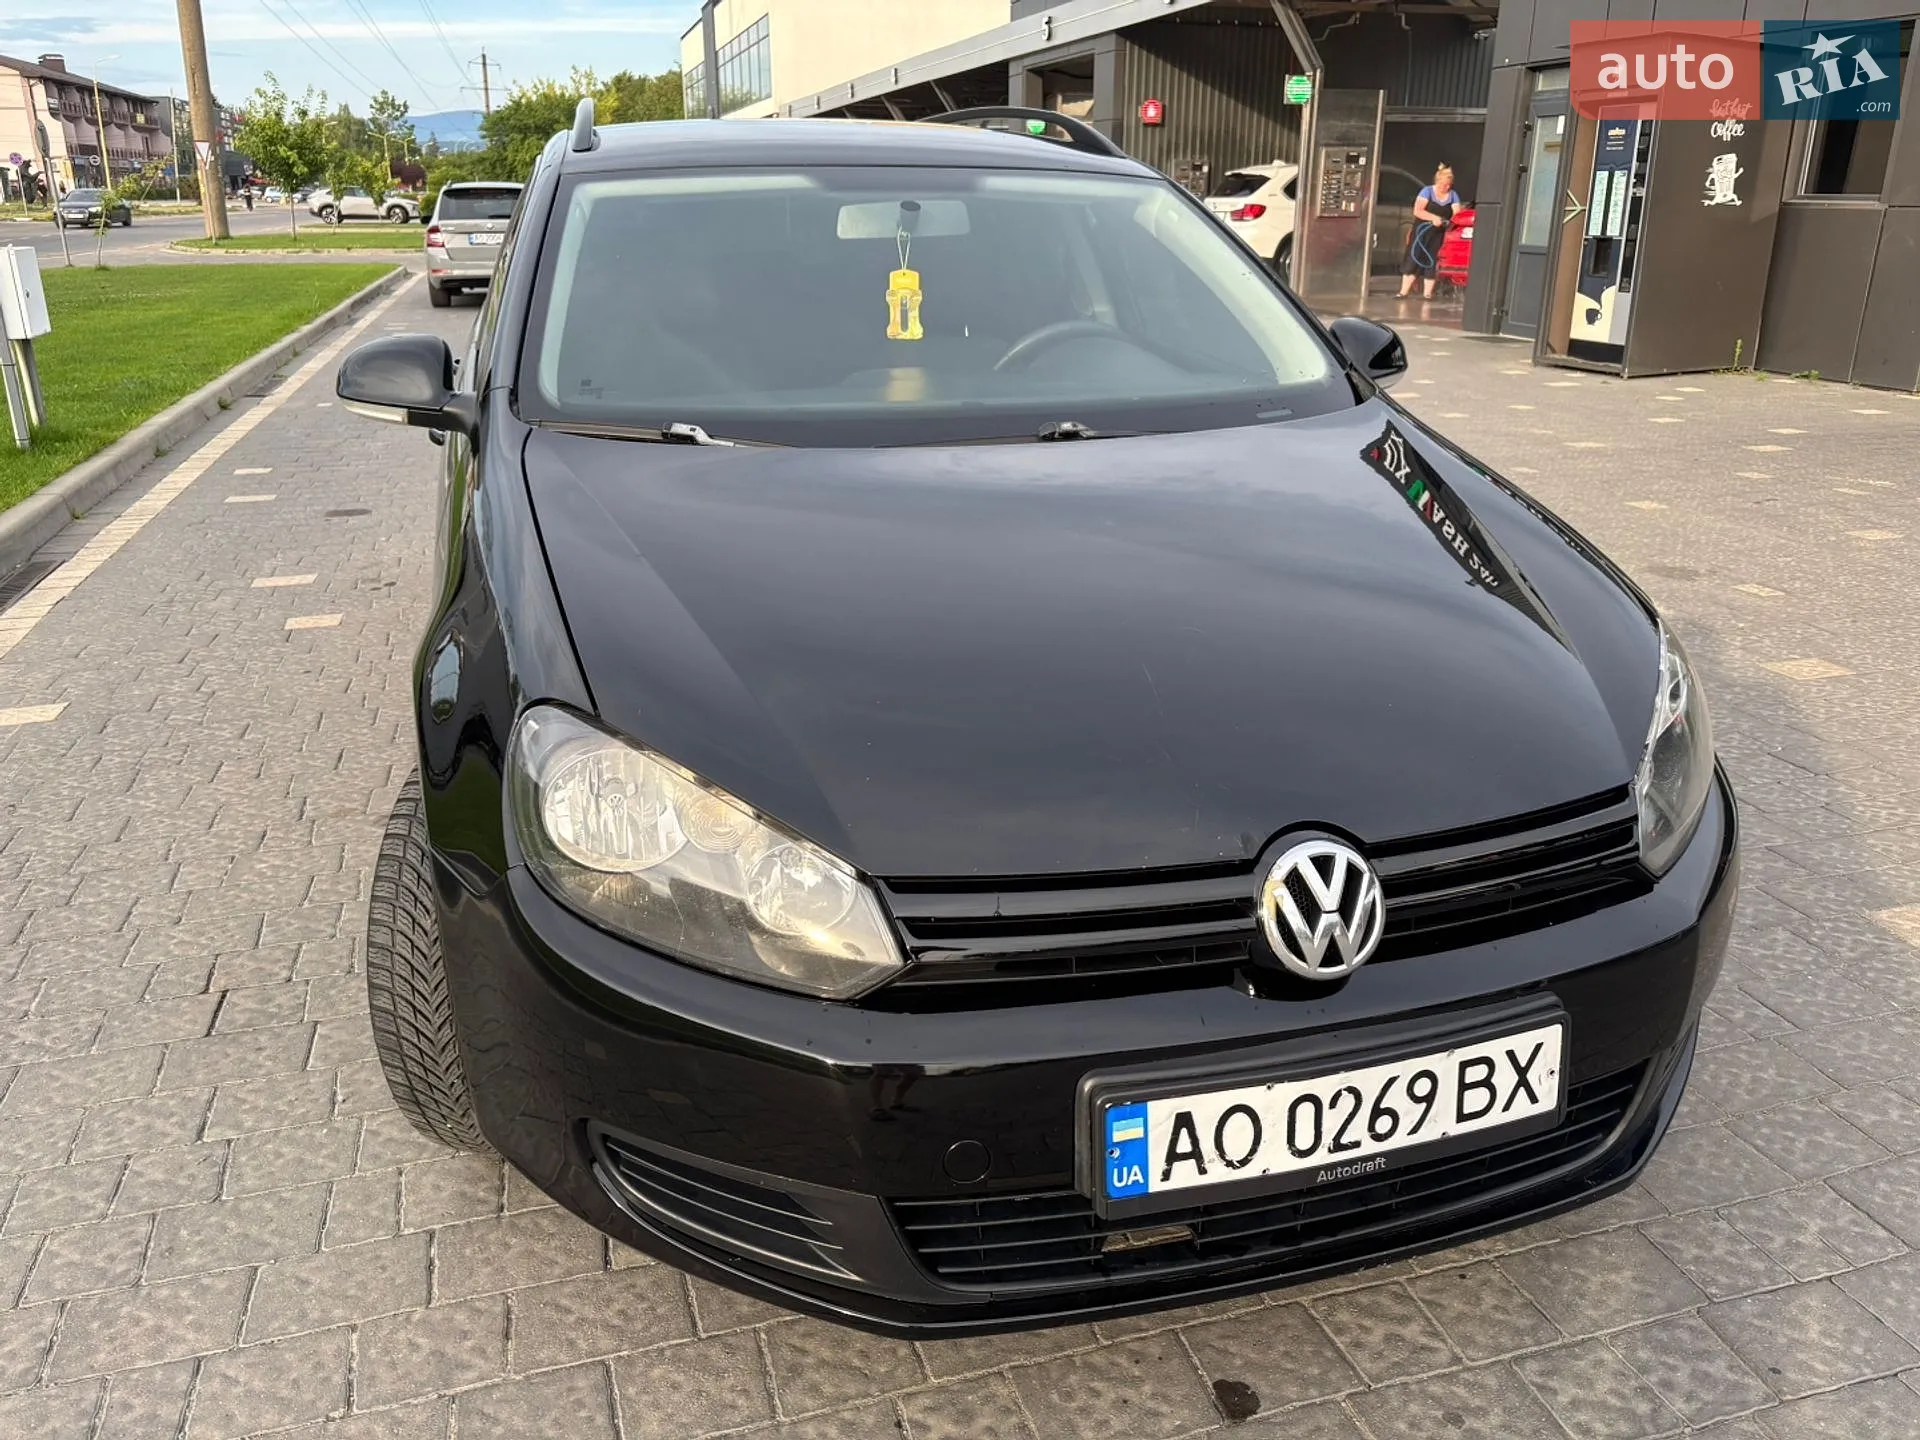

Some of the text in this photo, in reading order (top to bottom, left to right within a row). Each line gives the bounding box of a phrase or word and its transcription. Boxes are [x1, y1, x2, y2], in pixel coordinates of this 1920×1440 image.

[1160, 1041, 1545, 1182] AO 0269 BX
[1112, 1169, 1144, 1188] UA
[1317, 1157, 1387, 1183] Autodraft
